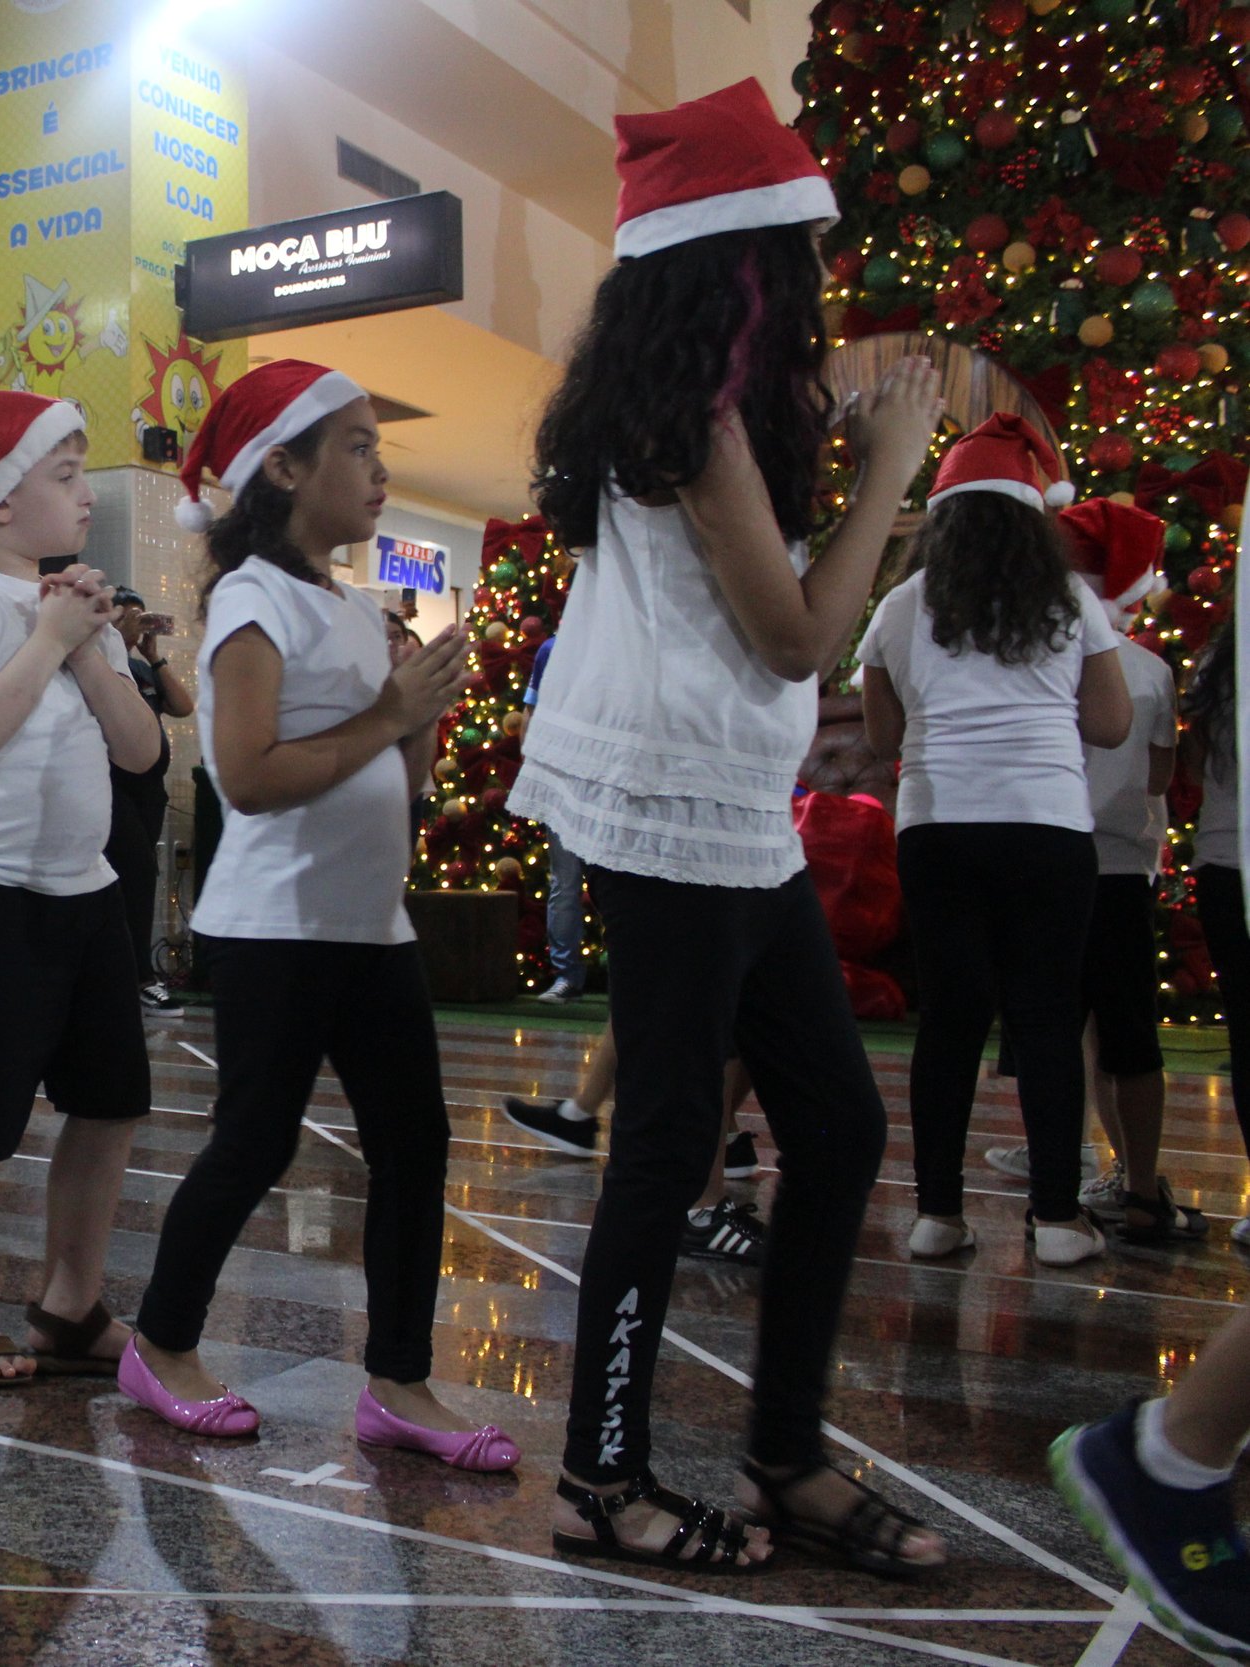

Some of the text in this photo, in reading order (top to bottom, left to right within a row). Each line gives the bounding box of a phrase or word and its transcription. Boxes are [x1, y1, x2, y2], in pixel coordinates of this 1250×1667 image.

[159, 47, 221, 94] VENHA
[43, 101, 59, 135] É
[138, 79, 239, 145] CONHECER
[154, 131, 218, 179] NOSSA
[166, 181, 214, 221] LOJA
[10, 207, 103, 248] A VIDA
[231, 220, 387, 276] MOÇA BIJU
[298, 259, 343, 275] Acessórios
[377, 535, 445, 595] TENNIS
[396, 541, 433, 560] WORLD
